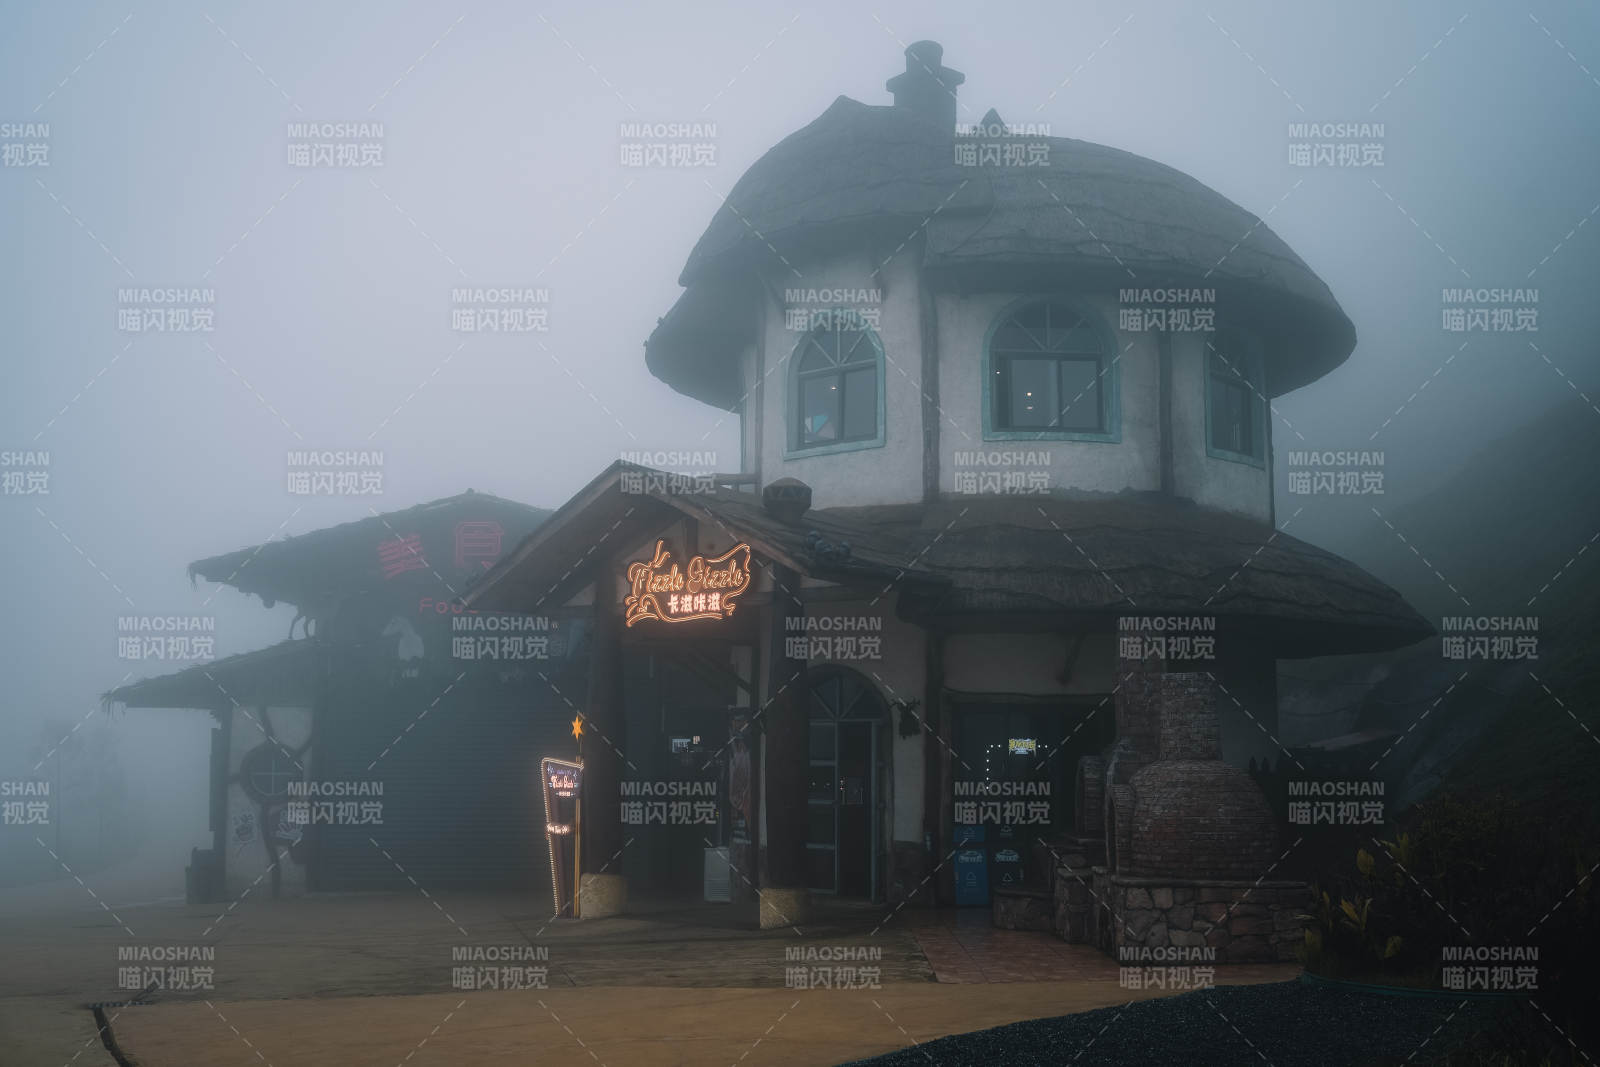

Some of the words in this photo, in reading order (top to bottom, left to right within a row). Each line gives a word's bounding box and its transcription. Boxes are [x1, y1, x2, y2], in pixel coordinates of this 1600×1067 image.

[686, 556, 744, 594] Sizzle
[668, 592, 721, 615] 卡滋咔滋
